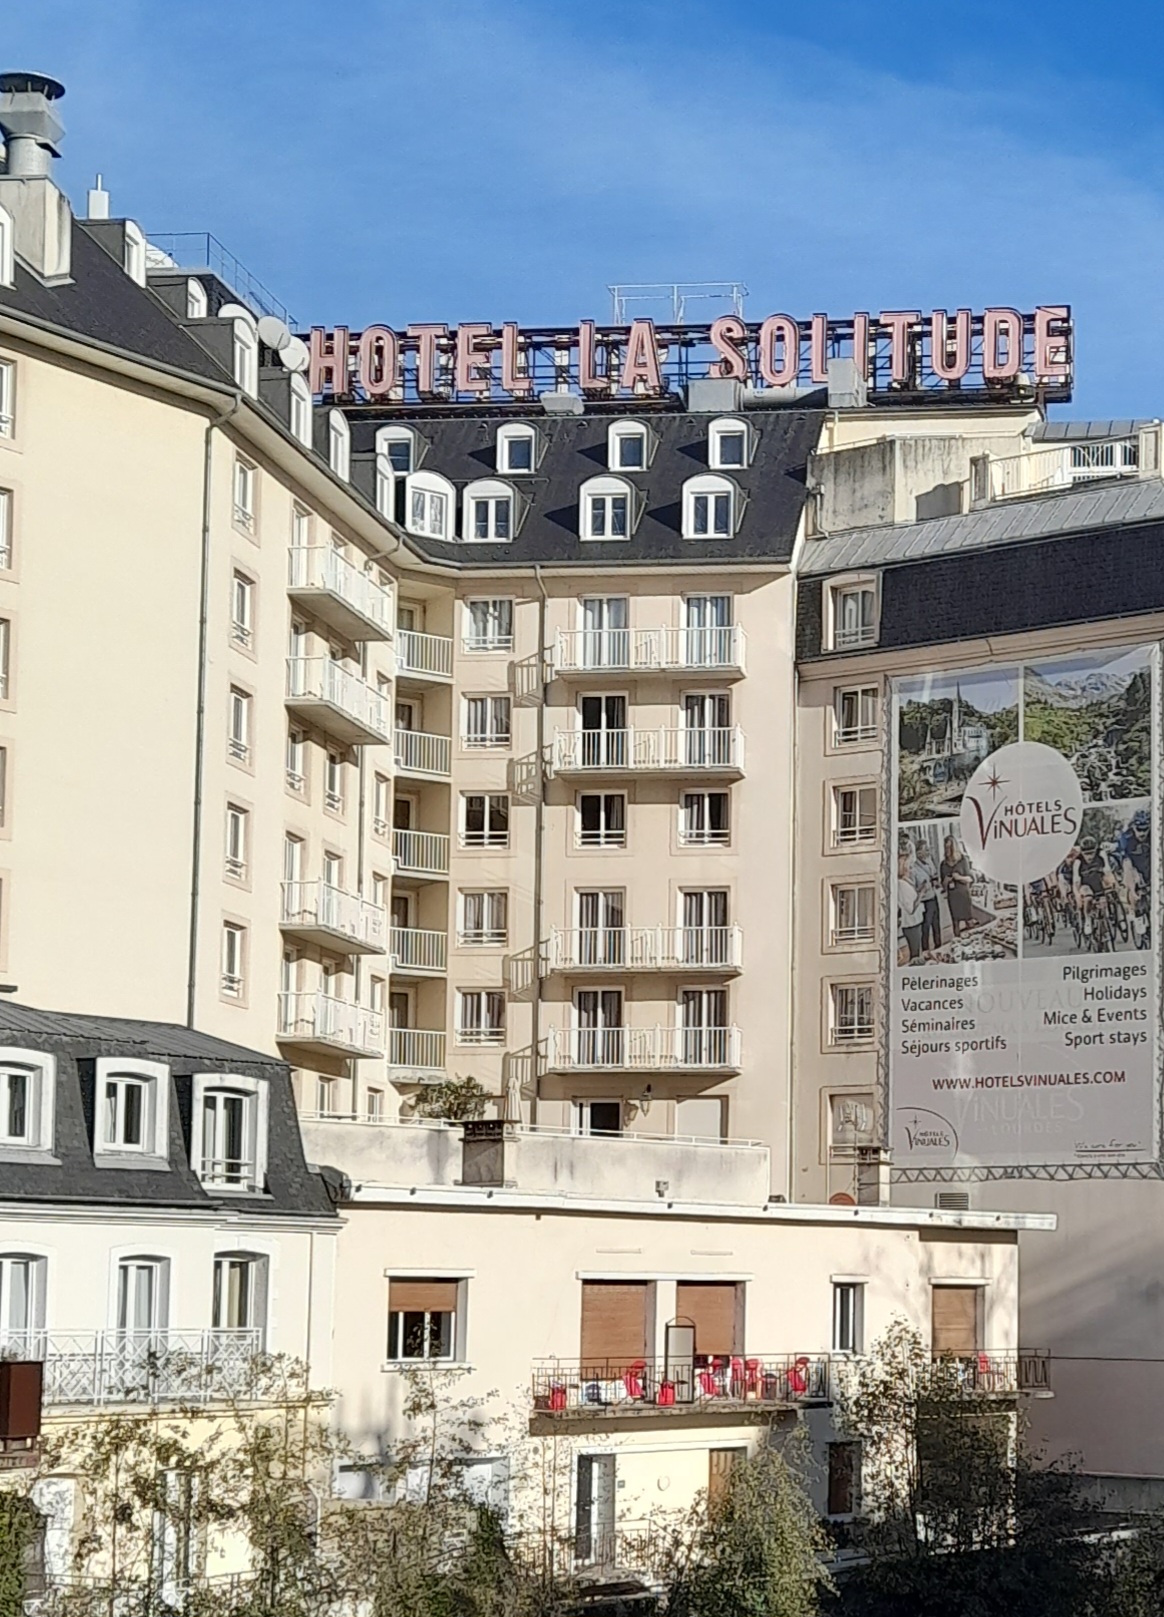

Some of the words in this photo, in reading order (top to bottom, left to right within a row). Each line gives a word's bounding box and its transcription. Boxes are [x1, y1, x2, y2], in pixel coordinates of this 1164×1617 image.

[310, 321, 533, 394] HOTEL
[579, 318, 662, 390] LA
[709, 305, 1070, 387] SOLITUDE
[1004, 799, 1062, 816] HÔTELS
[1063, 964, 1147, 984] Pilgrimages
[902, 975, 979, 992] Pèlerinages
[1083, 985, 1147, 1002] Holidays
[901, 998, 964, 1012] Vacances
[901, 1017, 976, 1033] Séminaires
[1043, 1010, 1078, 1025] Mice
[1081, 1008, 1093, 1024] &
[1097, 1008, 1147, 1023] Events
[901, 1039, 951, 1058] Séjours
[954, 1035, 1007, 1054] sportifs
[1064, 1031, 1105, 1050] Sport
[1109, 1031, 1147, 1046] stays
[932, 1071, 1126, 1090] WWW.HOTELSVINUALES.COM
